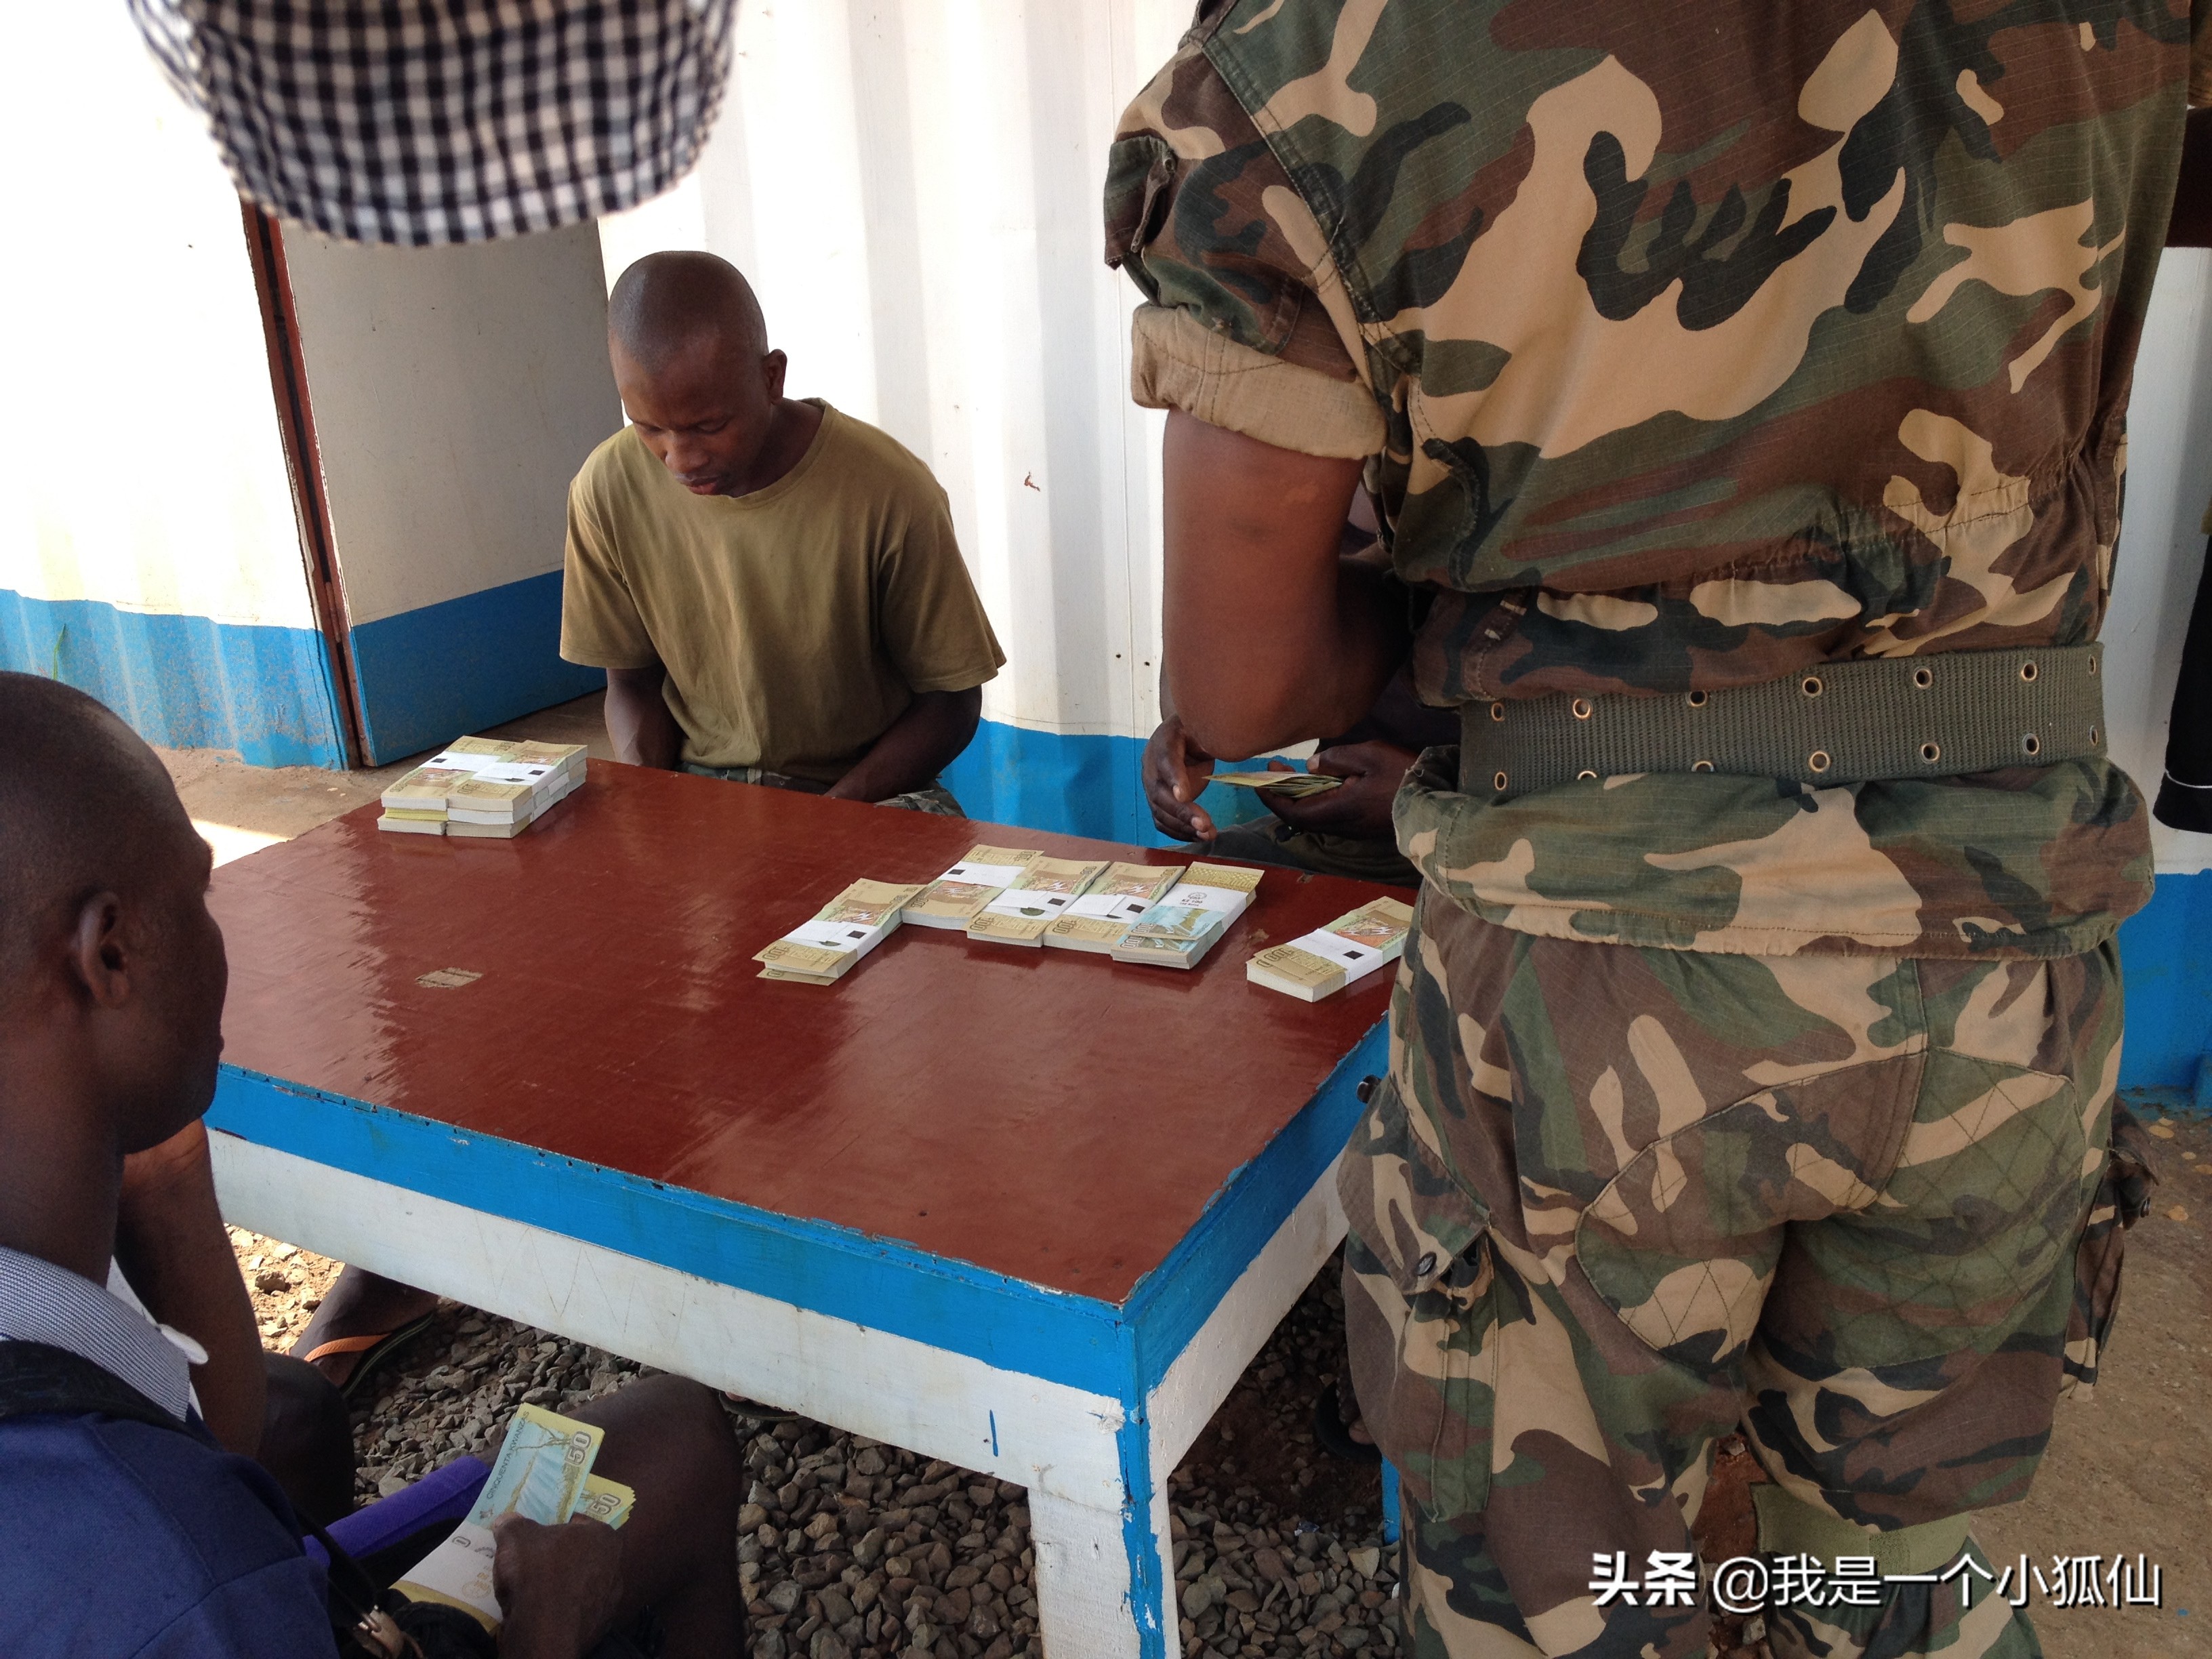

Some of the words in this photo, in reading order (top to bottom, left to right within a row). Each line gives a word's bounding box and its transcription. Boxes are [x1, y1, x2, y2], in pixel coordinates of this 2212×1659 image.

[970, 917, 994, 930] 100
[1052, 920, 1076, 933] 100
[762, 947, 790, 960] 100
[1264, 948, 1294, 962] 100
[487, 1452, 512, 1499] CINQUENTA
[510, 1411, 529, 1452] KWANZAS
[565, 1431, 592, 1465] 50
[587, 1493, 621, 1516] 50
